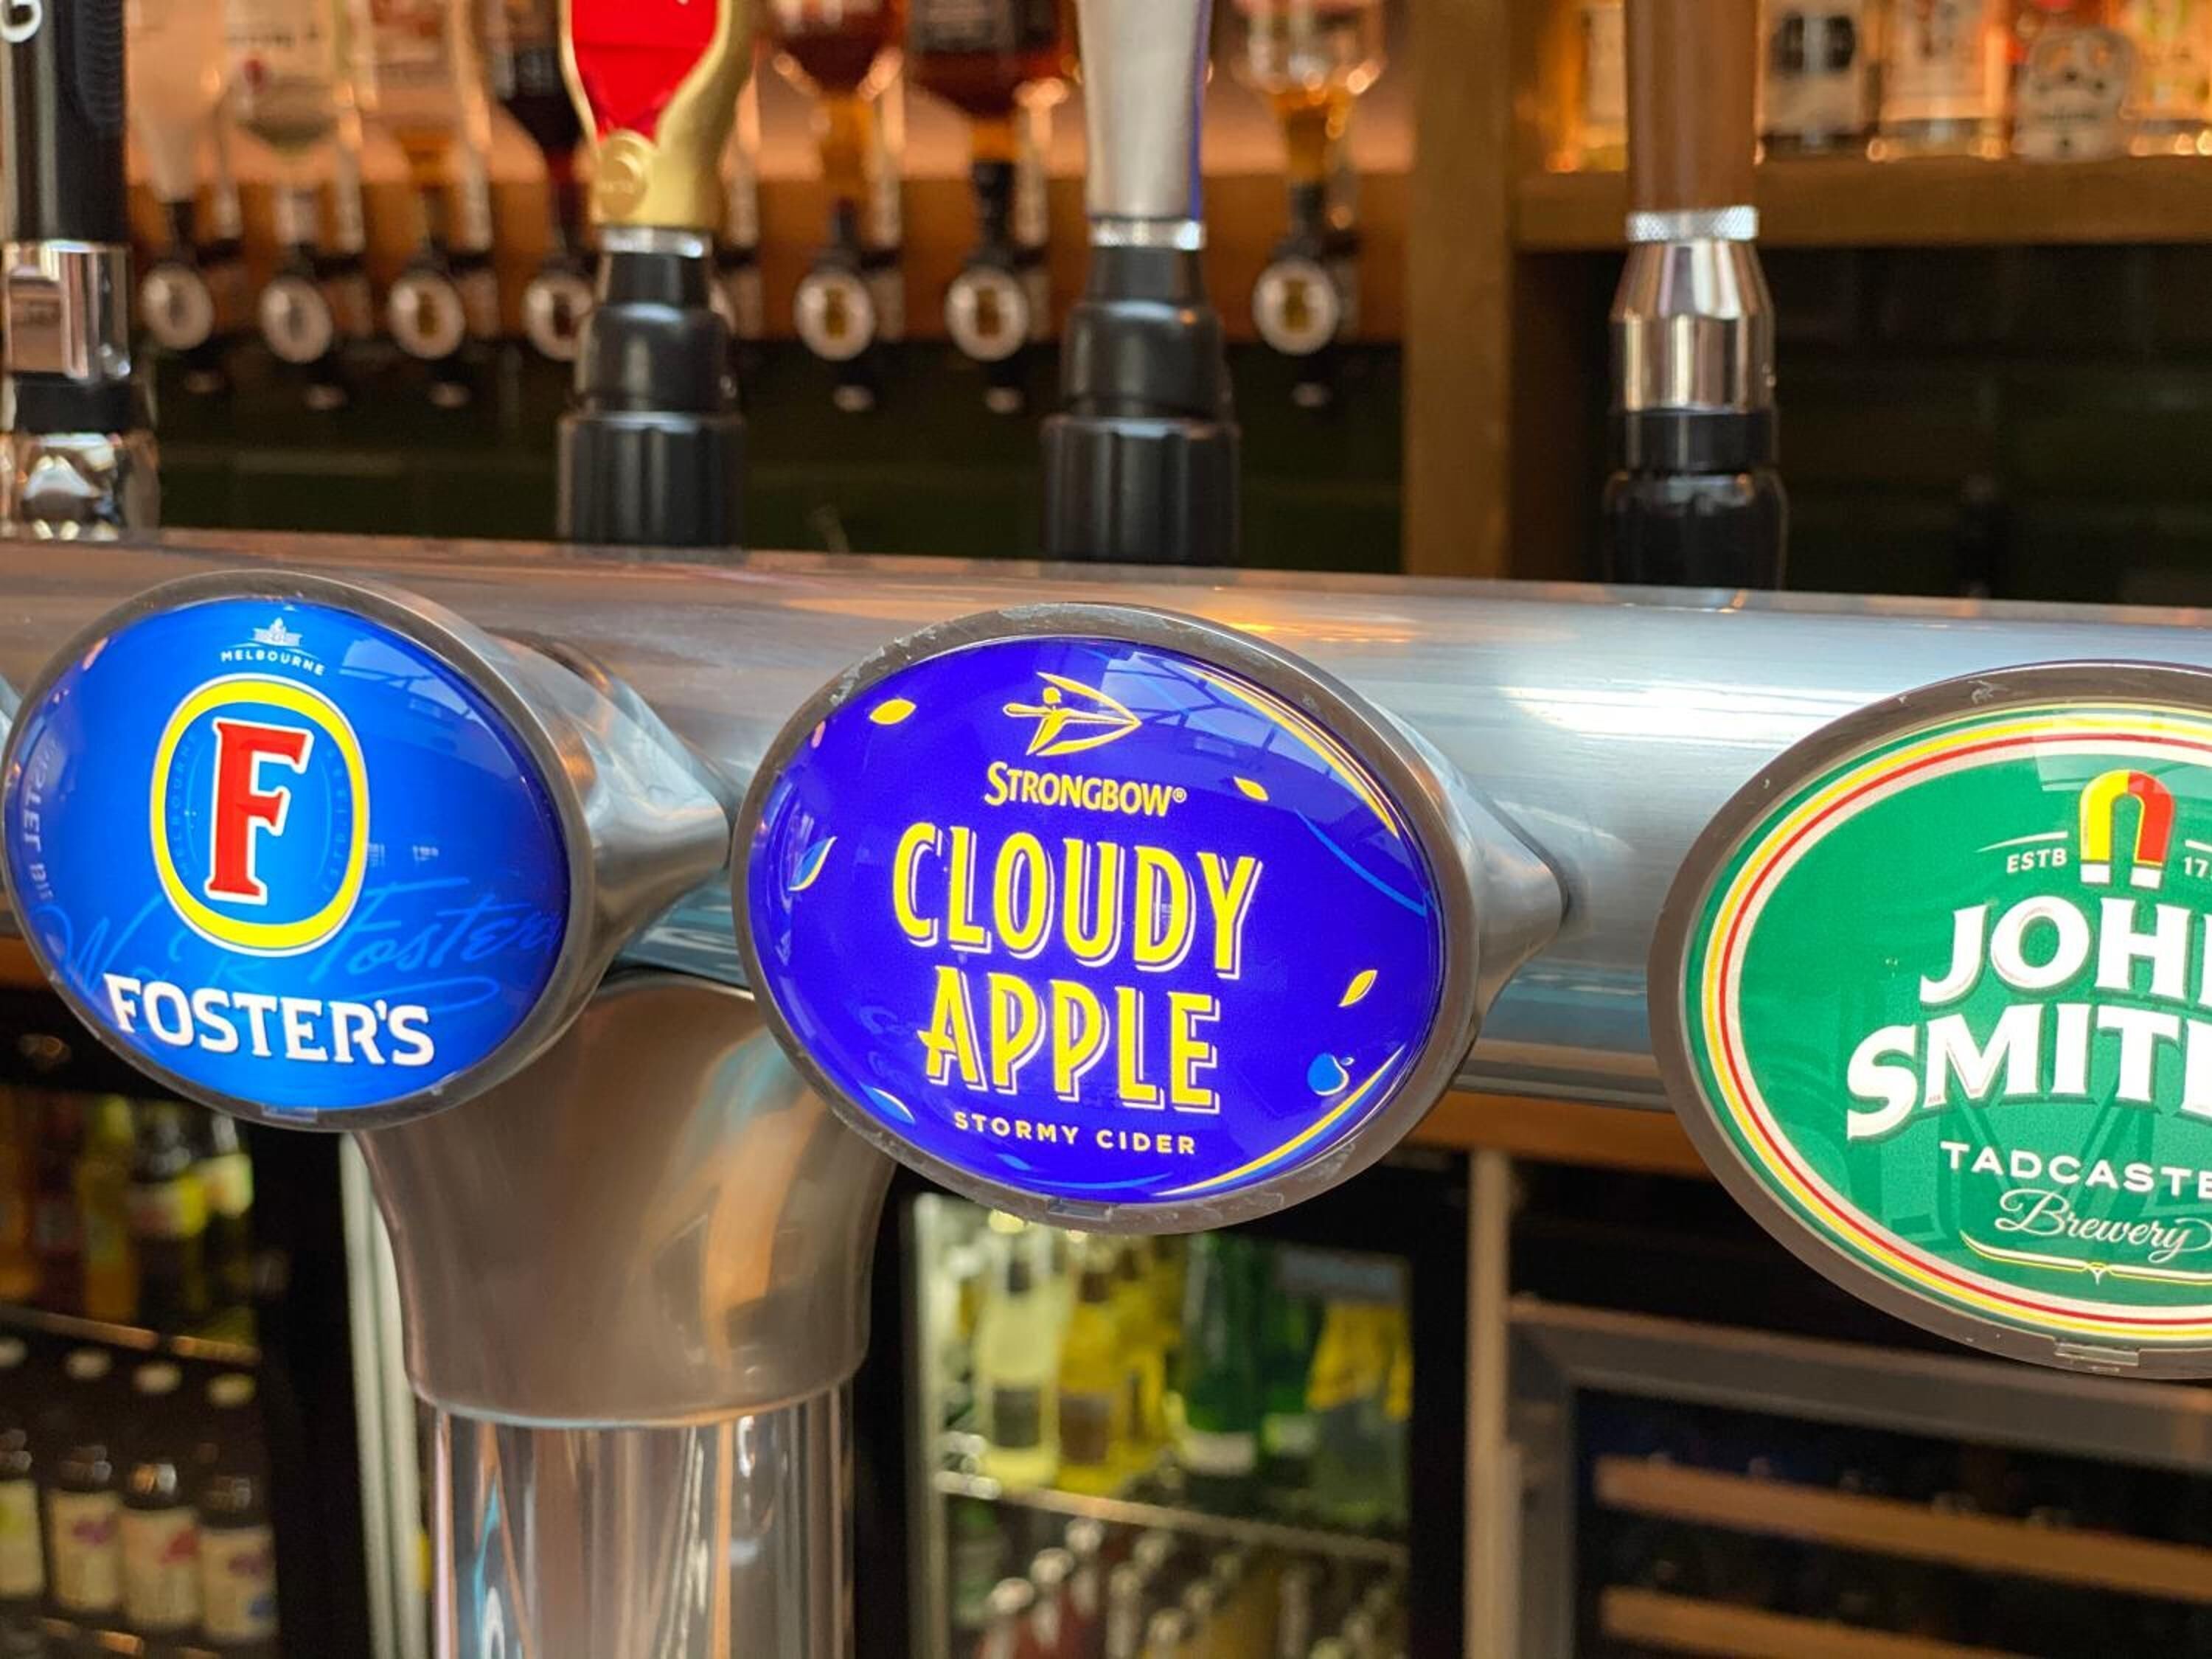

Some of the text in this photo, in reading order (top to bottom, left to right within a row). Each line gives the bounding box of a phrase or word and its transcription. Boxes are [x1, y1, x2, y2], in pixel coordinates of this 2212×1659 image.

[220, 649, 325, 676] MELBOURNE
[204, 717, 315, 906] F
[891, 821, 1263, 979] CLOUDY
[2006, 848, 2212, 880] ESTB 17
[1919, 894, 2212, 1009] JOH
[103, 973, 435, 1066] FOSTER'S
[917, 966, 1220, 1115] APPLE
[954, 1111, 1196, 1155] STORMY CIDER
[1994, 1188, 2212, 1263] Brewery
